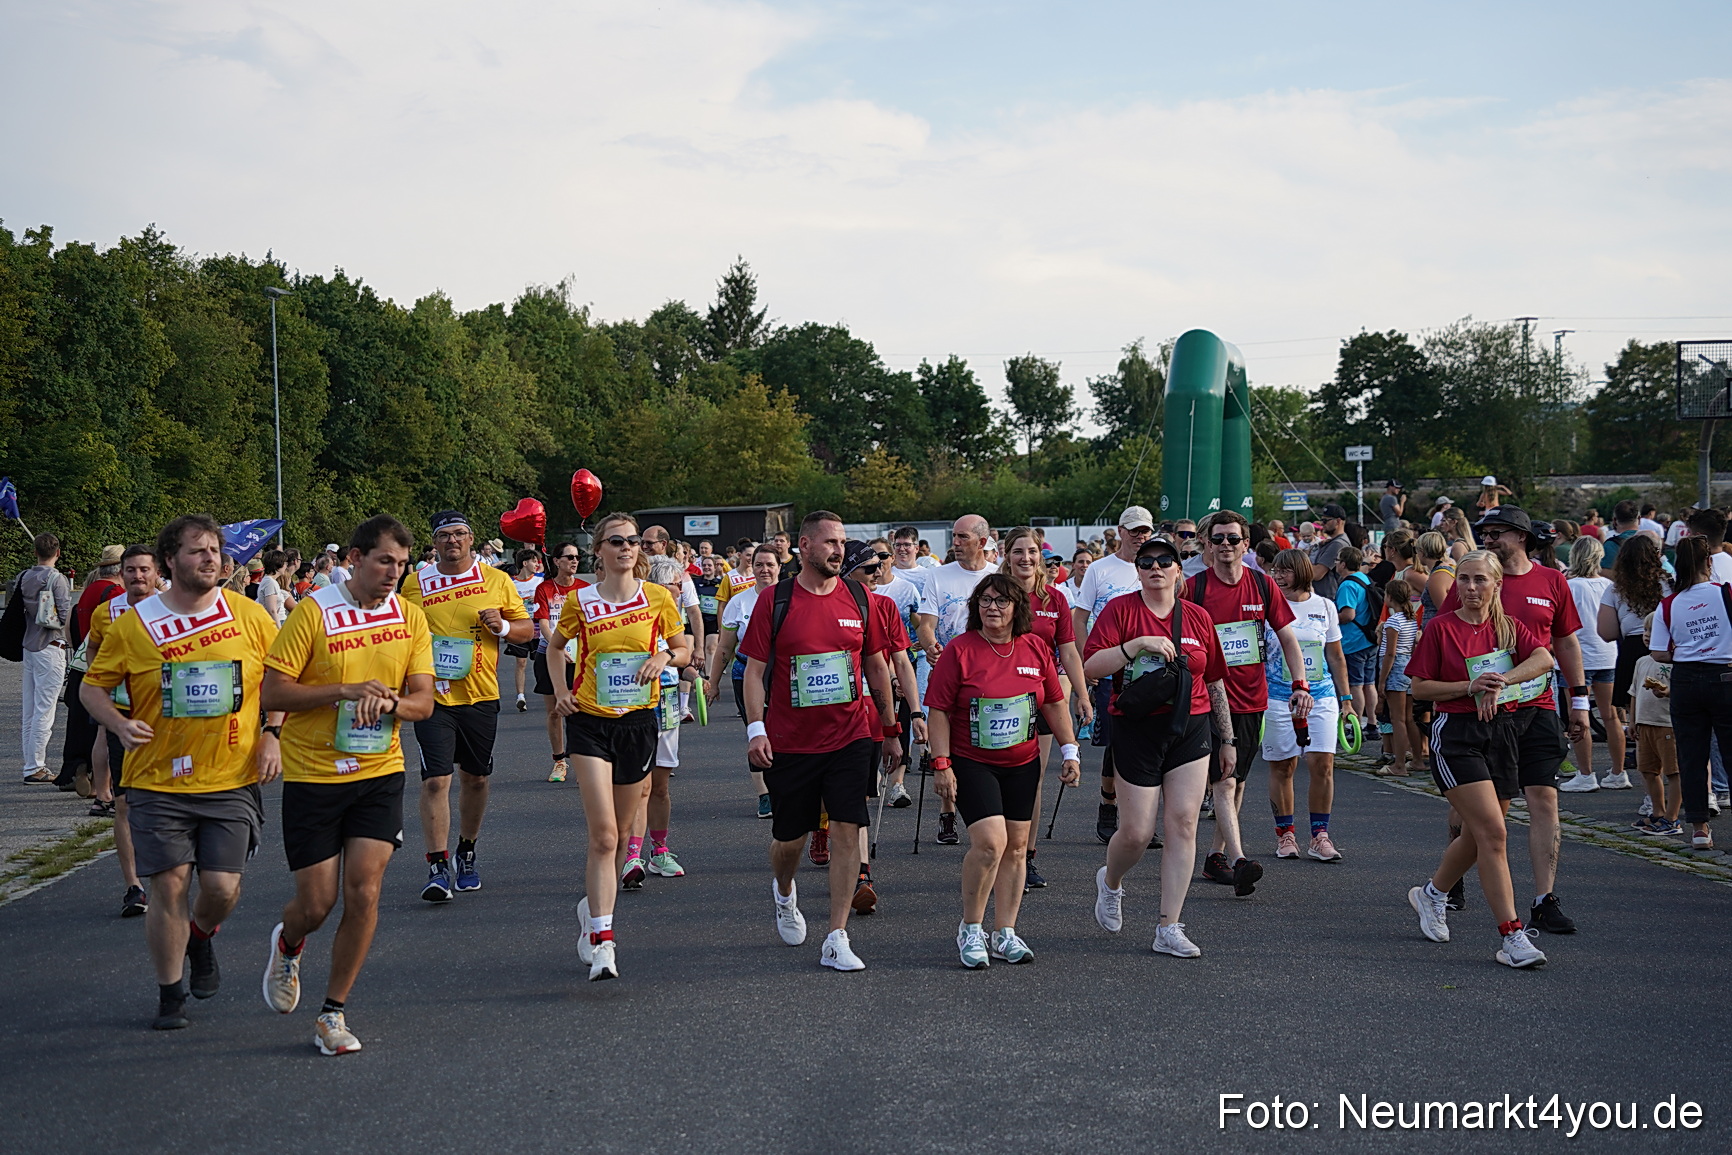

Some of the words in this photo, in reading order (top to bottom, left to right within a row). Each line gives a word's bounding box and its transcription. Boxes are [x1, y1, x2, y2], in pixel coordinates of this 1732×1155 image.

[423, 594, 451, 608] MAX
[455, 586, 488, 599] BÖGL
[1526, 596, 1551, 608] THULE
[1241, 603, 1264, 612] THULE
[588, 620, 618, 637] MAX
[620, 611, 653, 627] BÖGL
[837, 618, 862, 629] THULE
[1686, 620, 1698, 628] EIN
[1698, 615, 1720, 625] TEAM.
[1689, 627, 1702, 635] EIN
[1702, 623, 1720, 632] LAUF.
[161, 641, 196, 661] MAX
[199, 626, 242, 648] BÖGL
[328, 636, 367, 655] MAX
[370, 627, 412, 645] BÖGL
[1181, 637, 1200, 647] HULE
[1693, 633, 1703, 642] EIN
[1222, 638, 1249, 651] 2786
[438, 653, 459, 664] 1715
[1016, 667, 1041, 676] THULE
[607, 675, 638, 686] 1654
[807, 673, 840, 687] 2825
[185, 684, 218, 697] 1676
[989, 717, 1020, 730] 2778
